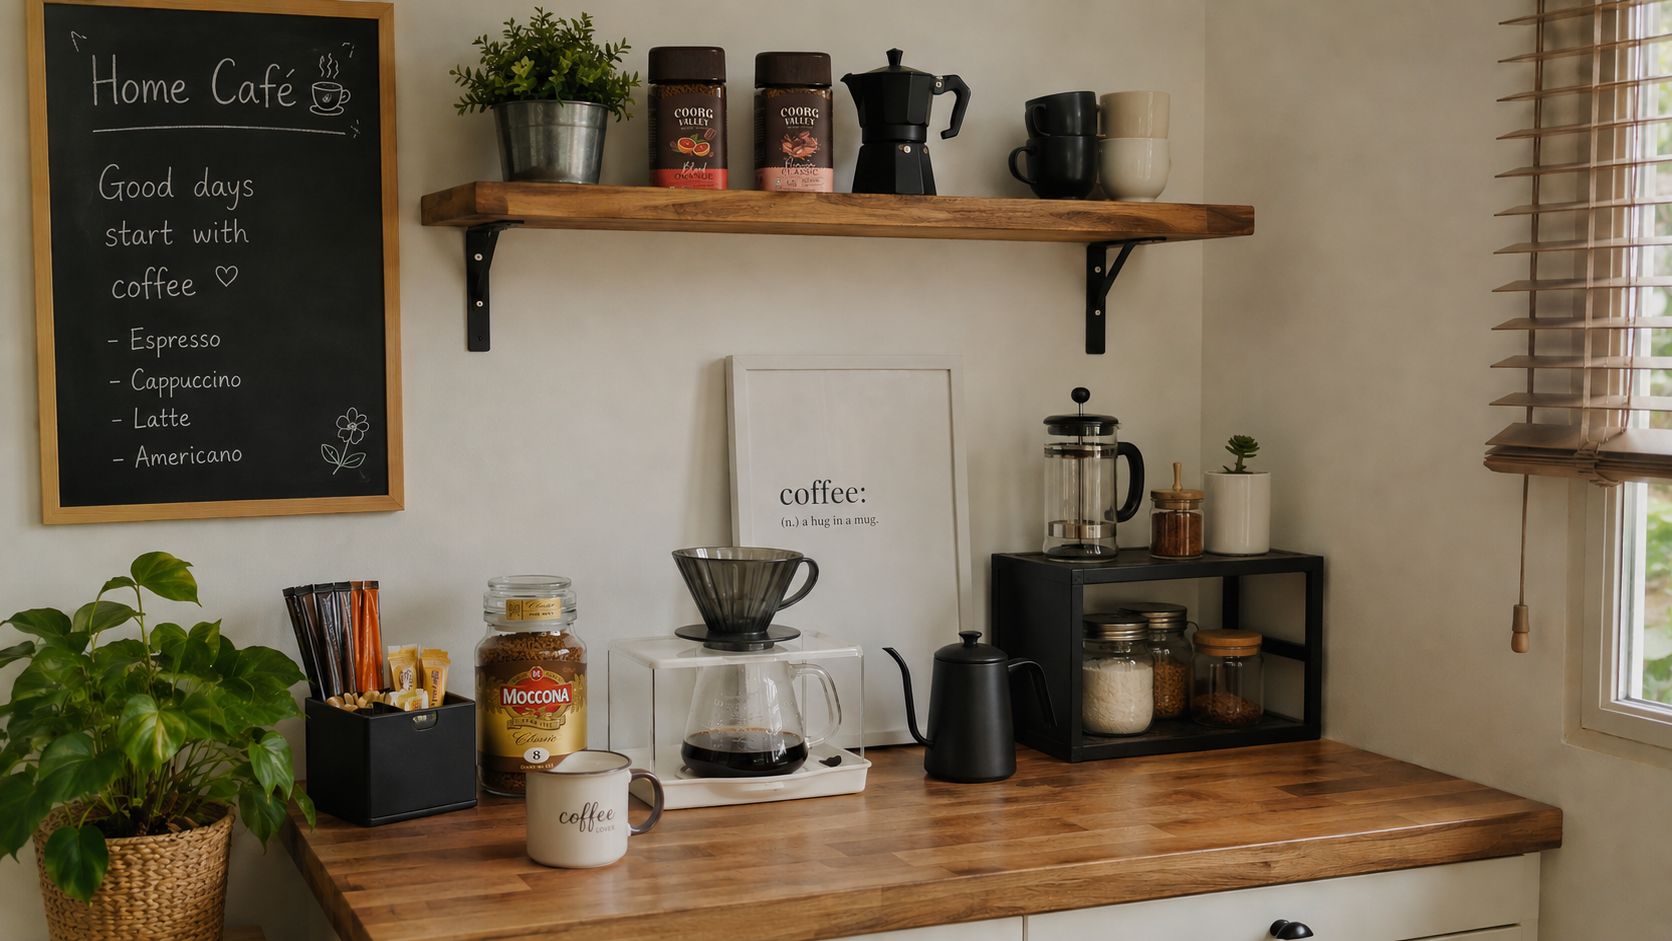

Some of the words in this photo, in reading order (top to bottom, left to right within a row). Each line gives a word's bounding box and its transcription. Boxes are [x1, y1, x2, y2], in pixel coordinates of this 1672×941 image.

[92, 54, 190, 106] Home
[211, 57, 297, 108] Café
[674, 107, 714, 119] COORG
[678, 118, 709, 127] VALLEY
[780, 106, 819, 119] COORG
[784, 117, 815, 126] VALLEY
[99, 163, 175, 202] Good
[193, 166, 254, 211] days
[105, 220, 174, 247] start
[193, 218, 250, 244] with
[111, 266, 197, 300] coffee
[130, 326, 221, 358] Espresso
[131, 367, 242, 398] Cappuccino
[133, 407, 191, 429] Latte
[135, 445, 243, 468] Americano
[780, 479, 866, 506] coffee:
[781, 516, 800, 528] (n.)
[802, 519, 808, 527] a
[811, 515, 831, 529] hug
[833, 515, 843, 526] in
[845, 518, 852, 526] a
[854, 516, 879, 528] mug.
[512, 731, 557, 746] Classic
[532, 750, 541, 761] 8
[558, 801, 617, 833] coffee
